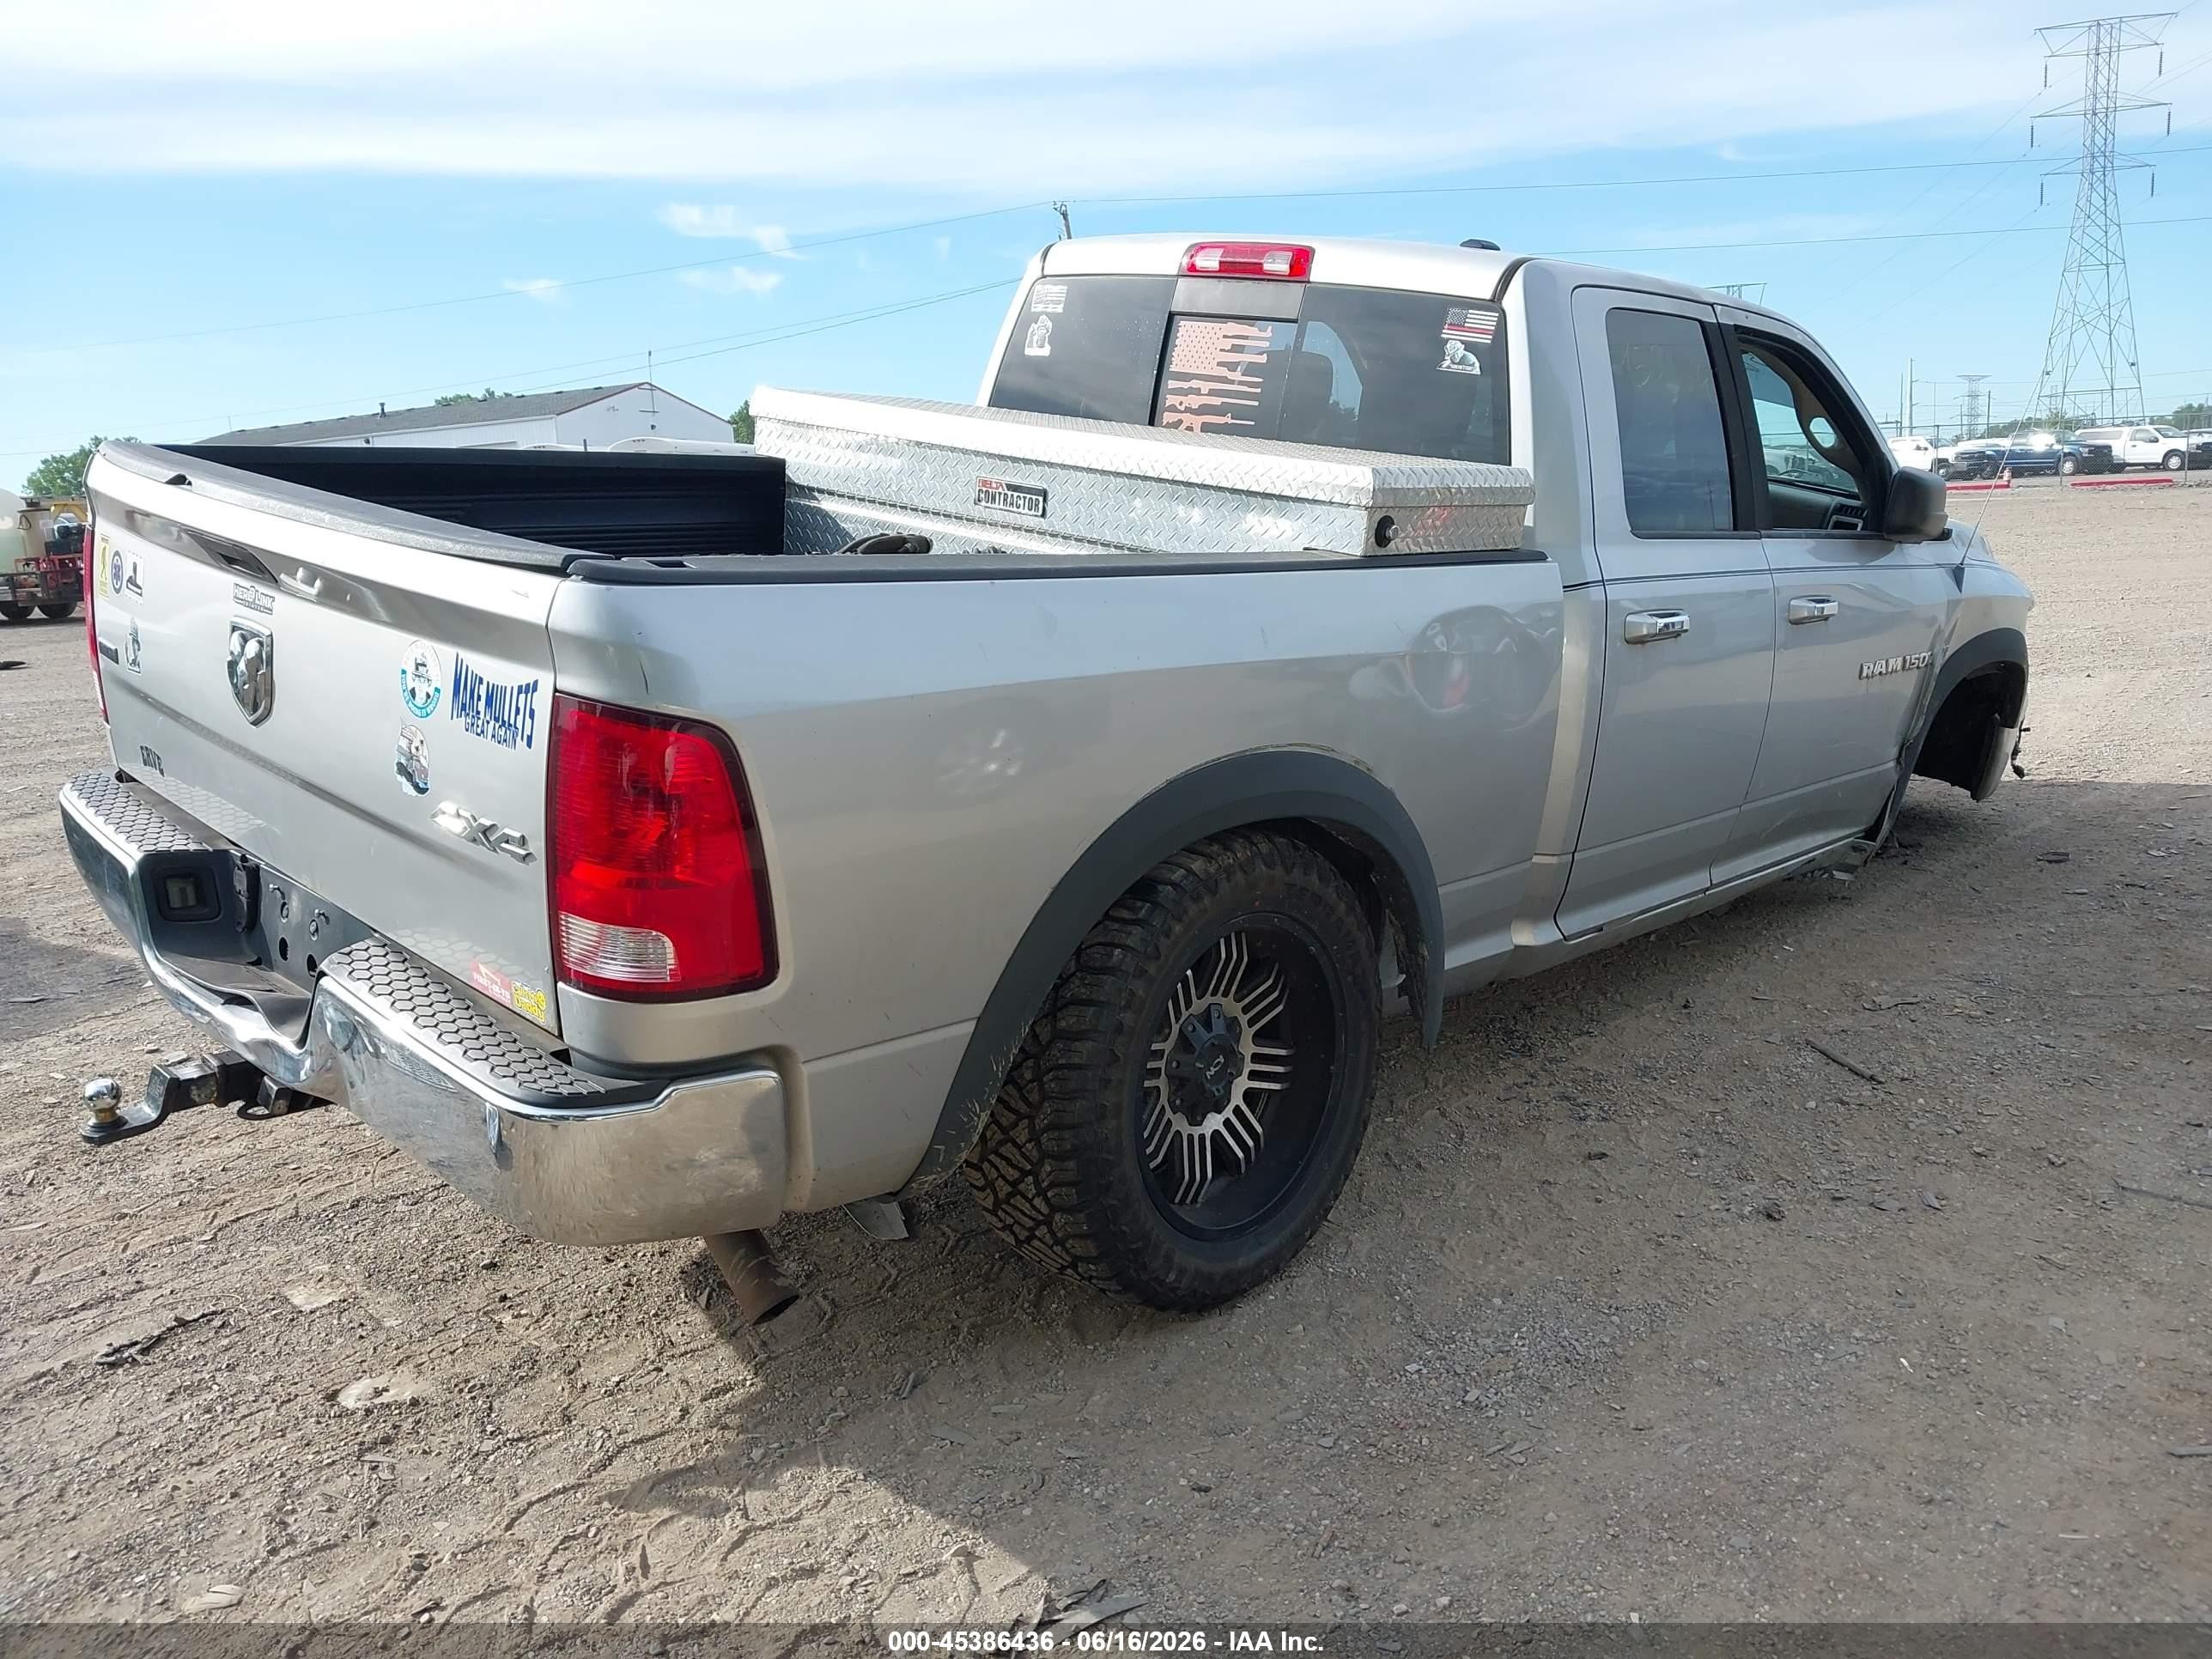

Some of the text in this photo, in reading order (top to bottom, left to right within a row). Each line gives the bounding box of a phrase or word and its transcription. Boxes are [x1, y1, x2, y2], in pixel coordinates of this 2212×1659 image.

[978, 478, 1005, 492] DELTA
[977, 489, 1041, 514] CONTRACTOR
[1858, 656, 1904, 681] RAM
[450, 652, 483, 720] MAKE
[483, 678, 539, 750] MULLETS
[465, 712, 519, 751] GREAT AGAIN
